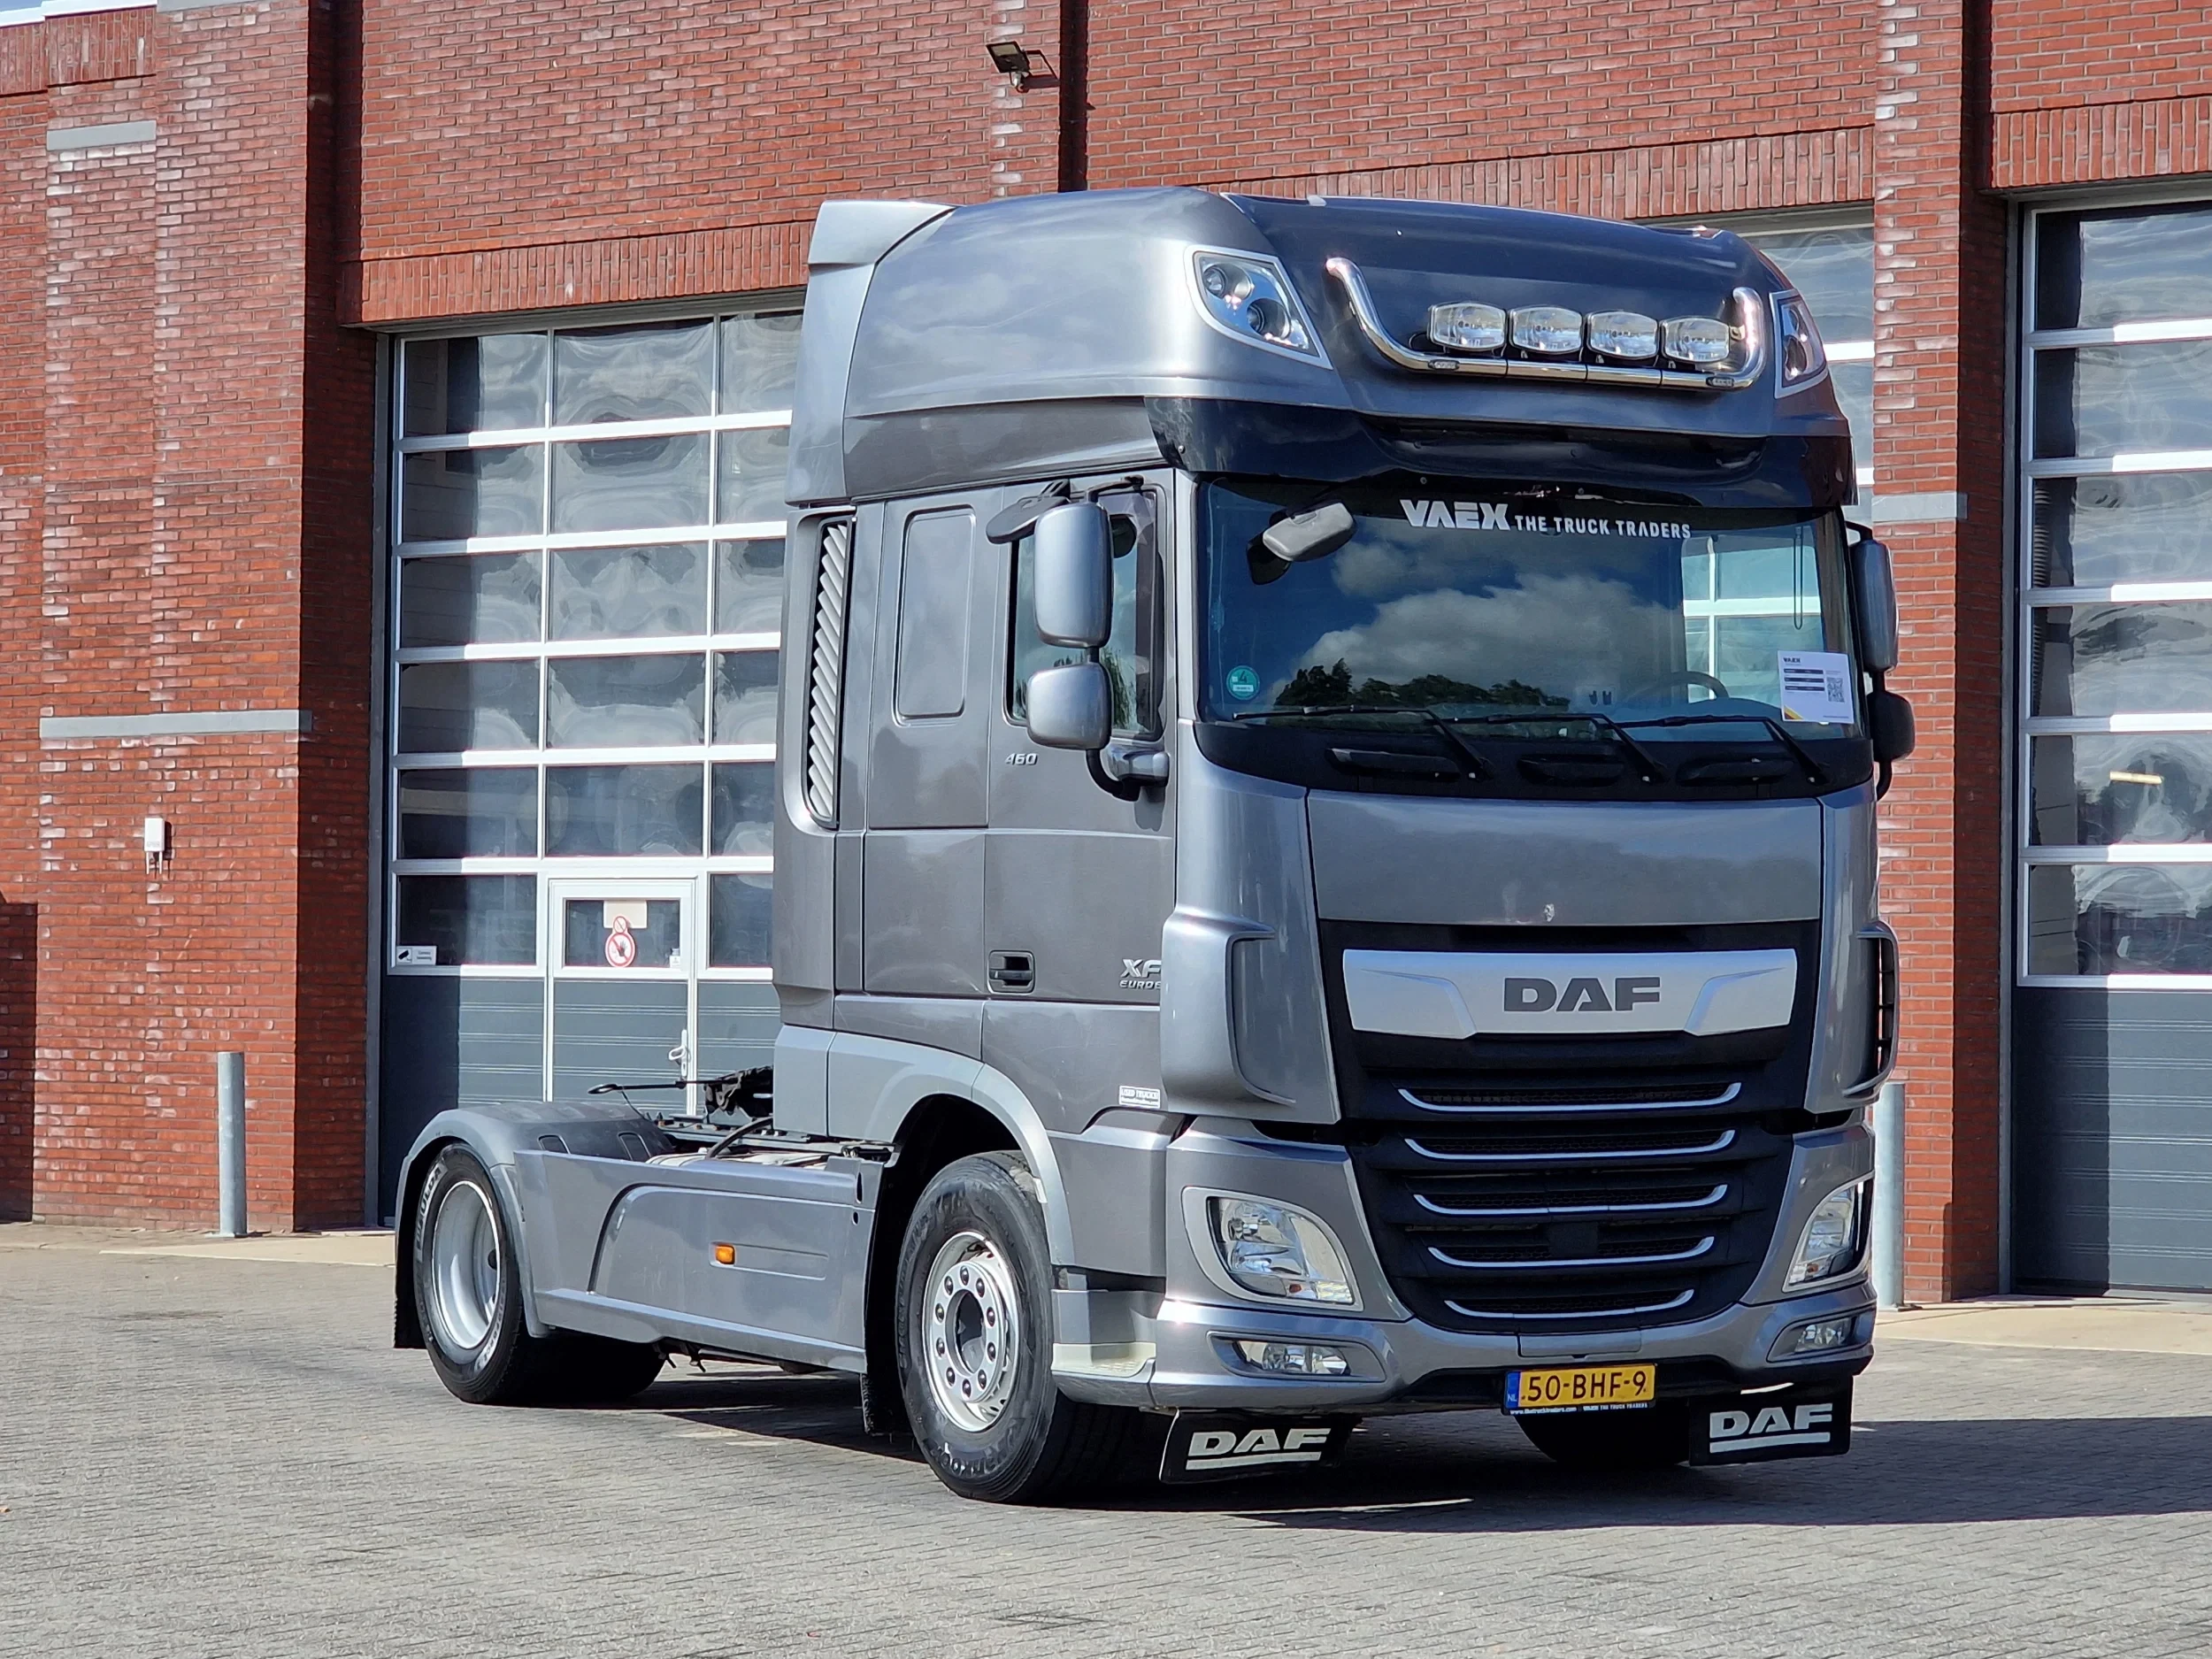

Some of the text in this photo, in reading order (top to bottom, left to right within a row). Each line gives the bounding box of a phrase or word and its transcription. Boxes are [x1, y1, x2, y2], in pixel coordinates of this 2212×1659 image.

[1400, 499, 1692, 539] VAEX THE TRUCK TRADERS
[1239, 670, 1248, 683] 4
[1005, 753, 1038, 765] 460
[1120, 959, 1162, 978] XF
[1503, 977, 1661, 1012] DAF
[1507, 1394, 1517, 1402] NL
[1527, 1371, 1647, 1402] 50-BHF-9
[1709, 1403, 1833, 1439] DAF
[1187, 1428, 1331, 1457] DAF
